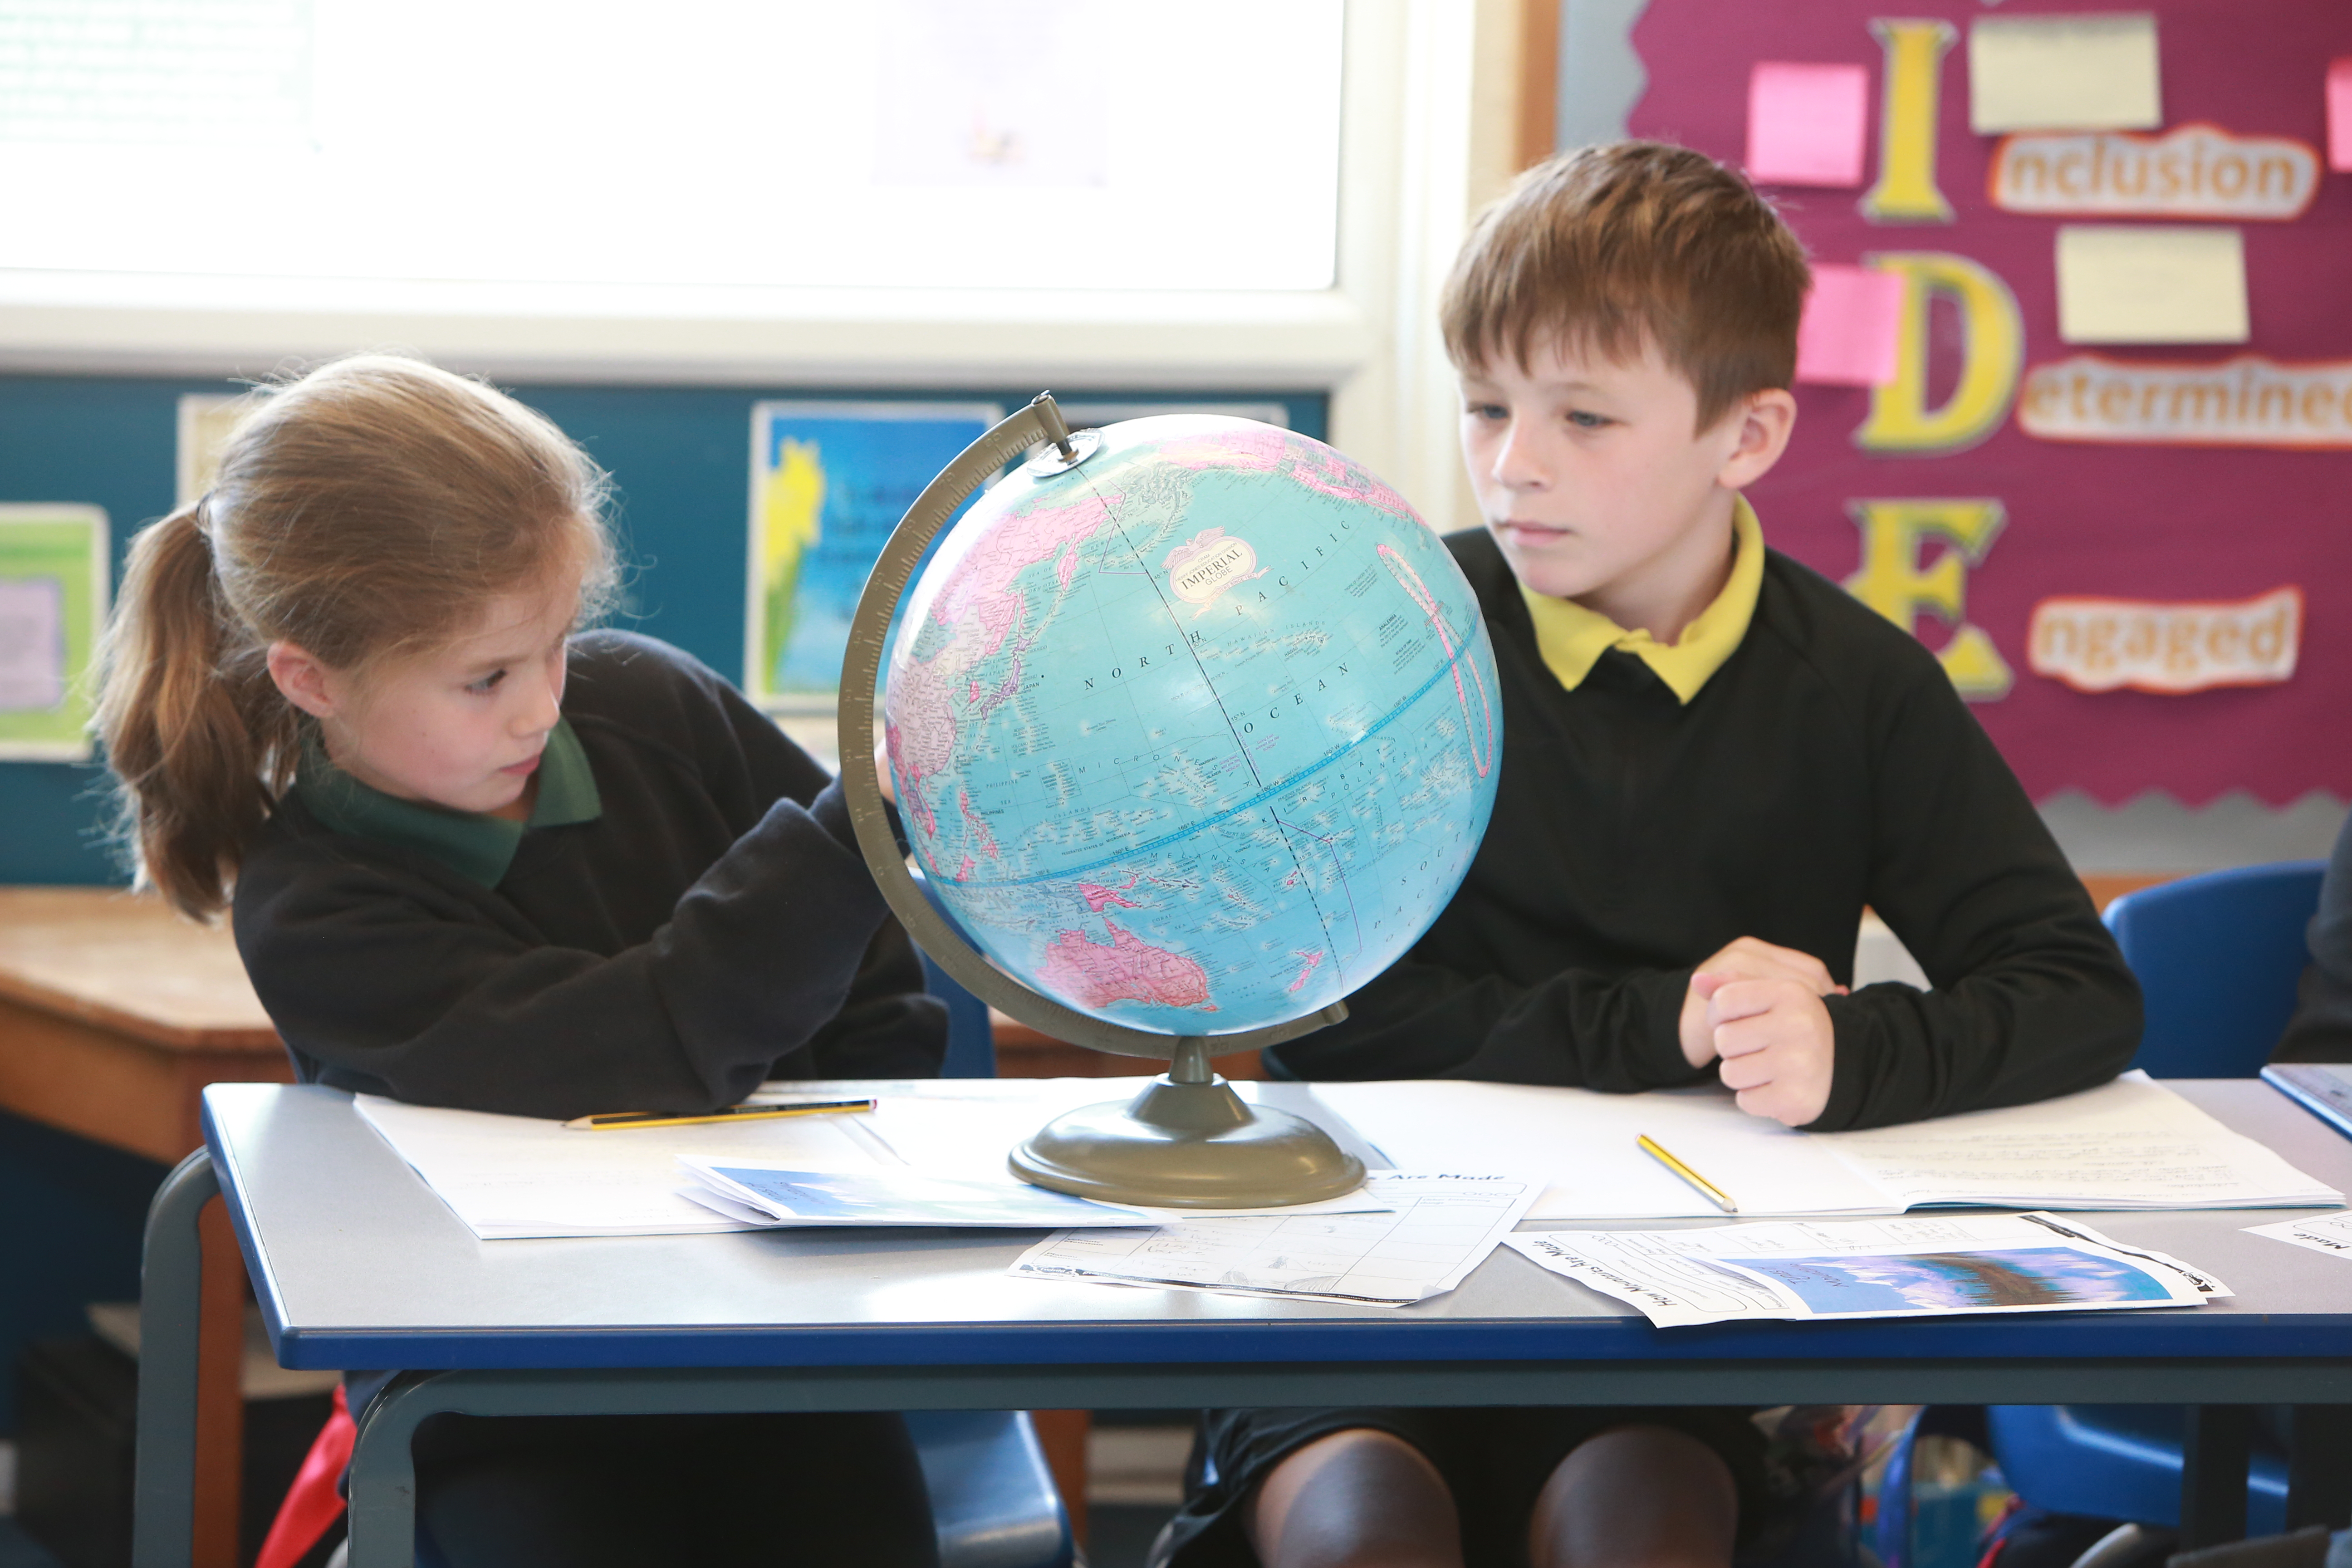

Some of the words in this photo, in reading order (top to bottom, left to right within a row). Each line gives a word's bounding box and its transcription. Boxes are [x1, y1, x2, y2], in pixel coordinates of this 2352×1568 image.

[2011, 137, 2294, 199] nclusion
[1189, 565, 1201, 575] JONES
[1200, 552, 1222, 567] EDUCATION
[1221, 542, 1238, 555] DIVISION
[1197, 553, 1210, 563] CRAM
[1181, 549, 1243, 590] IMPERIAL
[1205, 566, 1233, 585] GLOBE
[1206, 584, 1230, 606] PUBLISHERS
[1230, 577, 1245, 586] SINCE
[1084, 630, 1202, 690] NORTH
[1235, 520, 1350, 616] PACIFIC
[1378, 613, 1397, 631] ANALEMMA
[1227, 628, 1274, 647] HAWAIIAN
[1285, 621, 1325, 630] ISLANDS
[2042, 610, 2287, 671] ngaged
[1192, 640, 1201, 648] 30°
[1284, 646, 1299, 657] HAWAII
[1244, 662, 1348, 733] OCEAN
[1198, 756, 1219, 767] MARSHALL
[1225, 764, 1241, 773] MONDAY
[1206, 770, 1222, 779] ISLANDS
[1178, 823, 1190, 831] 165°
[1112, 848, 1124, 856] 150°
[1235, 844, 1251, 853] TUVALU
[1150, 852, 1271, 873] MELANESIA
[1532, 1240, 1571, 1257] Made
[2293, 1232, 2351, 1250] Made
[1564, 1256, 1592, 1269] Are
[1585, 1266, 1650, 1293] Mountains
[1643, 1292, 1678, 1307] How
